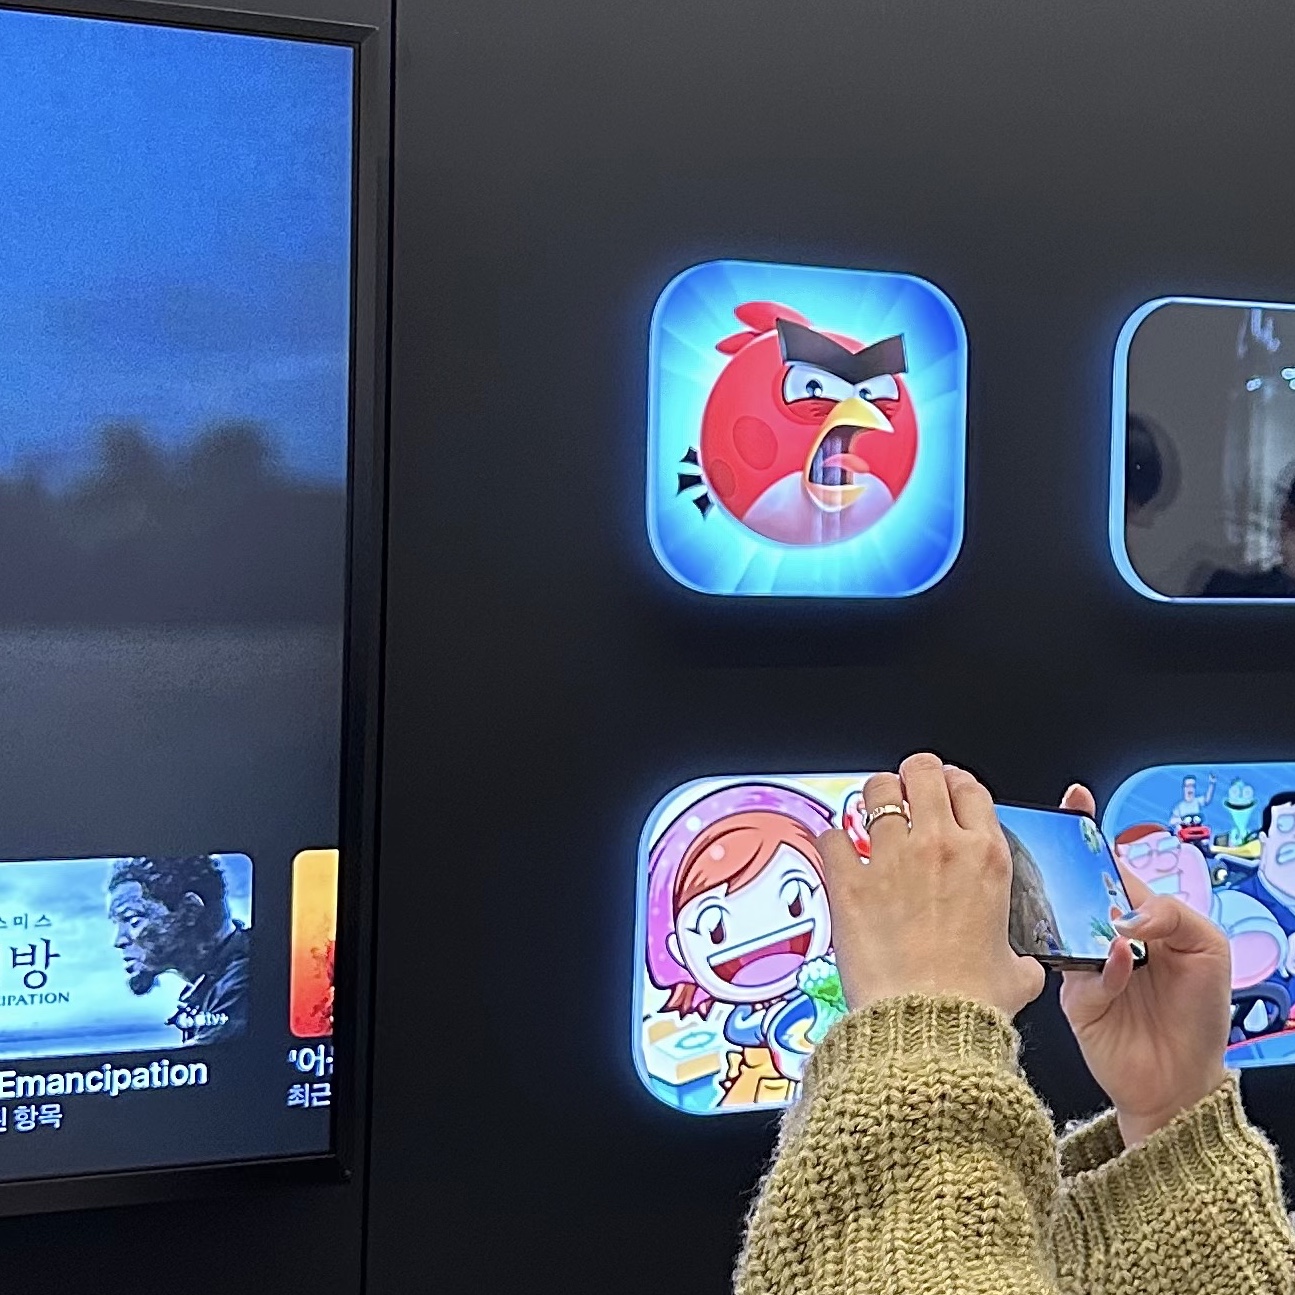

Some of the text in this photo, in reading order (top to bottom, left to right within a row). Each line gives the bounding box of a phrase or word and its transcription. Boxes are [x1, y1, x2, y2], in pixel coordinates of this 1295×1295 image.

[9, 937, 61, 989] 방
[0, 1058, 208, 1100] Emancipation
[286, 1082, 332, 1108] 최근
[13, 1103, 63, 1133] 항목
